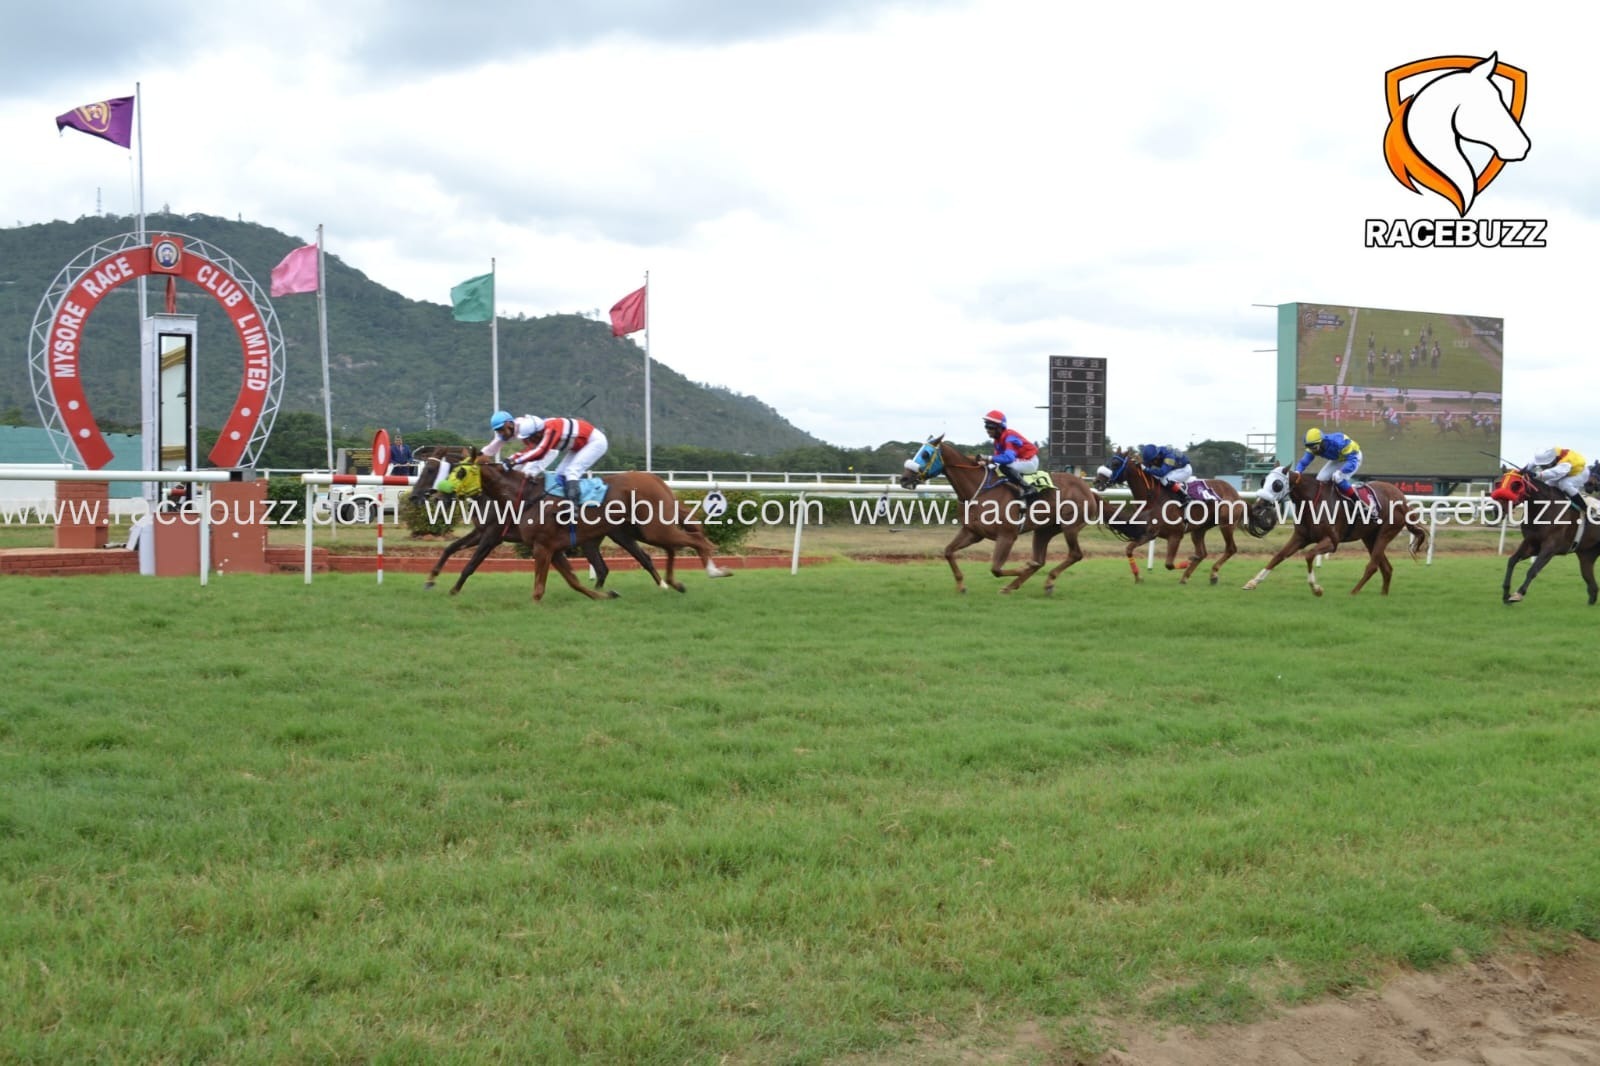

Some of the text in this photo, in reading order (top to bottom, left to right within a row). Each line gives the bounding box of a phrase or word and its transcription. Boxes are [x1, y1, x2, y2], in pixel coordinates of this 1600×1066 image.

[54, 257, 269, 391] MYSORE RACE CLUB LIMITED
[708, 493, 722, 514] 2
